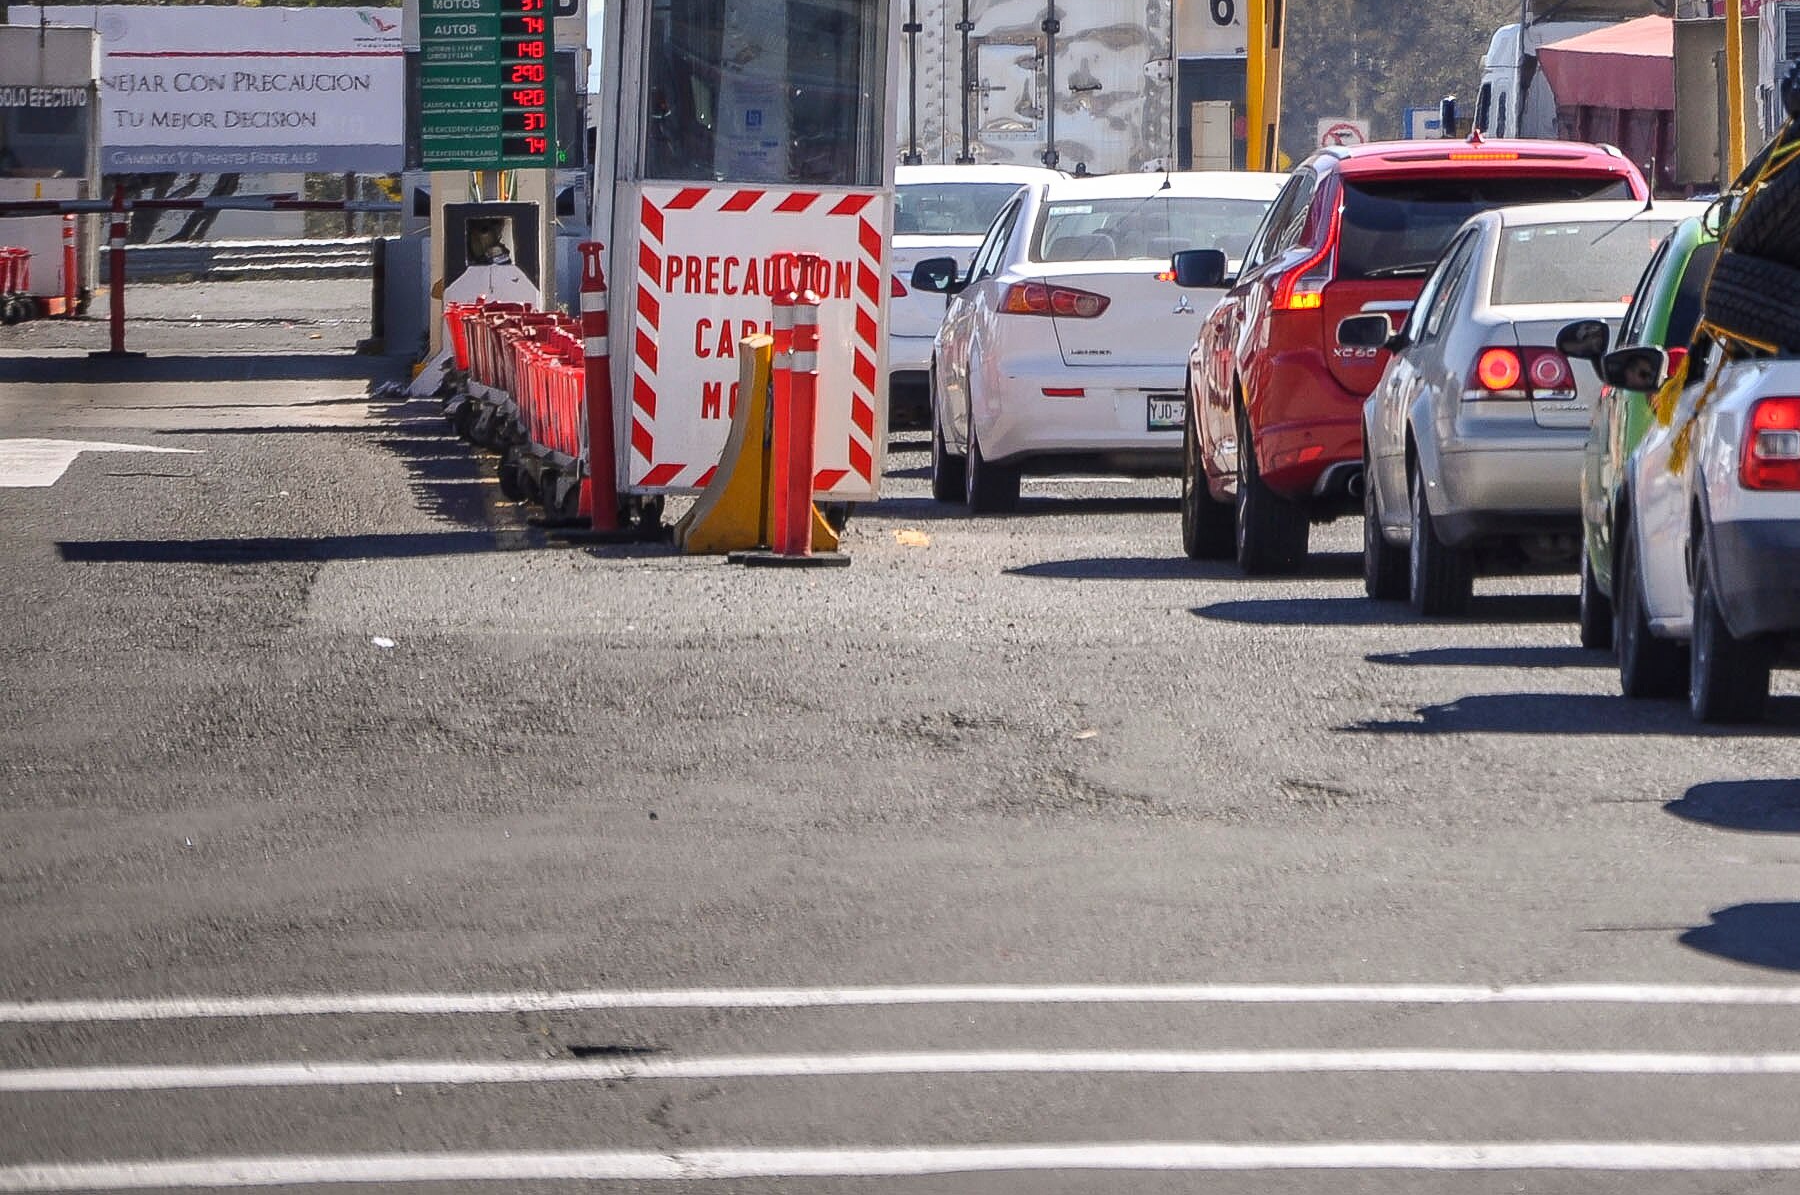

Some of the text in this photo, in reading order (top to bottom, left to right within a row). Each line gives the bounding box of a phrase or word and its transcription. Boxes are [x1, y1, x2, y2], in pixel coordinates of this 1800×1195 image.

[434, 17, 544, 35] AUTOS 74
[517, 41, 545, 58] 148
[173, 72, 227, 92] CON
[232, 71, 371, 92] PRECAUCION
[511, 64, 545, 83] 290
[29, 87, 87, 108] EFECTIVO
[512, 89, 545, 107] 420
[113, 109, 317, 130] TU MEJOR DECISION
[523, 112, 547, 131] 37
[524, 137, 547, 154] 74
